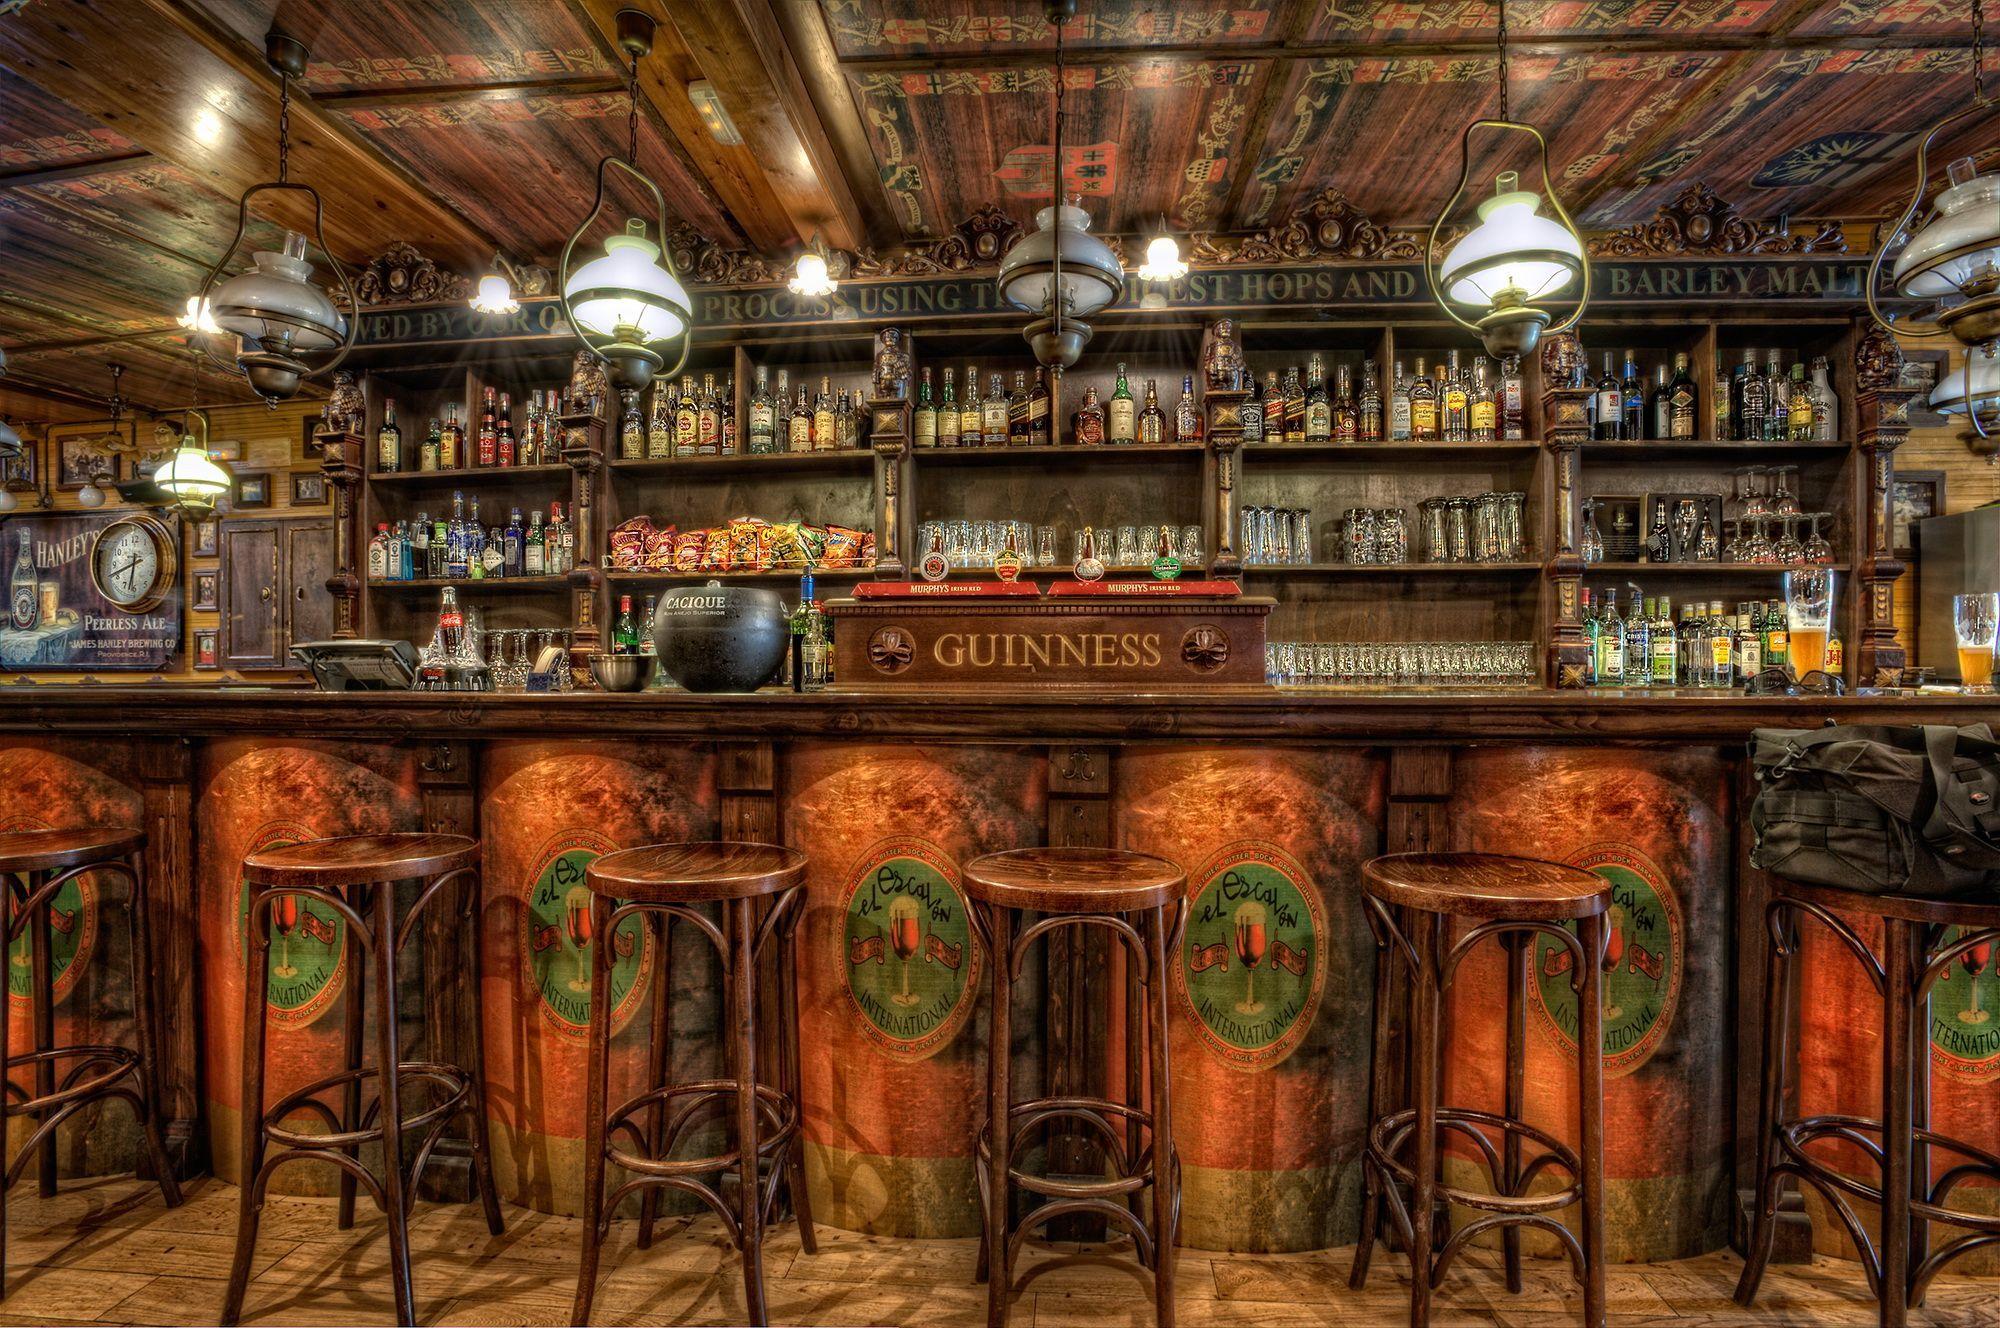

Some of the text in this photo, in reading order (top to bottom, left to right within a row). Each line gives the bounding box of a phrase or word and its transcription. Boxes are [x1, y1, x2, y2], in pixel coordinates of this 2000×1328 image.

[1241, 271, 1335, 301] HOPS
[1342, 269, 1417, 298] AND
[1610, 266, 1760, 296] BARLEY
[1767, 265, 1867, 295] MALT
[860, 282, 962, 314] USING
[420, 311, 458, 338] BY
[666, 596, 726, 609] CACIQUE
[84, 614, 166, 631] PEERLESS ALE
[71, 639, 96, 649] JAMES
[99, 639, 126, 649] HANLEY
[128, 639, 163, 649] BREWING
[933, 633, 1161, 667] GUINNESS
[1254, 850, 1275, 863] BOCK
[1580, 854, 1607, 867] BITTER
[1612, 855, 1632, 865] BOCK
[269, 966, 328, 1006] RNATIONAL
[541, 975, 627, 1022] INTERNATAL
[860, 989, 954, 1036] INTERNATIONAL
[1200, 997, 1298, 1045] INTERNATIONAL
[1554, 1002, 1656, 1050] INTATIONAL
[1931, 1018, 2000, 1055] TERNATIO
